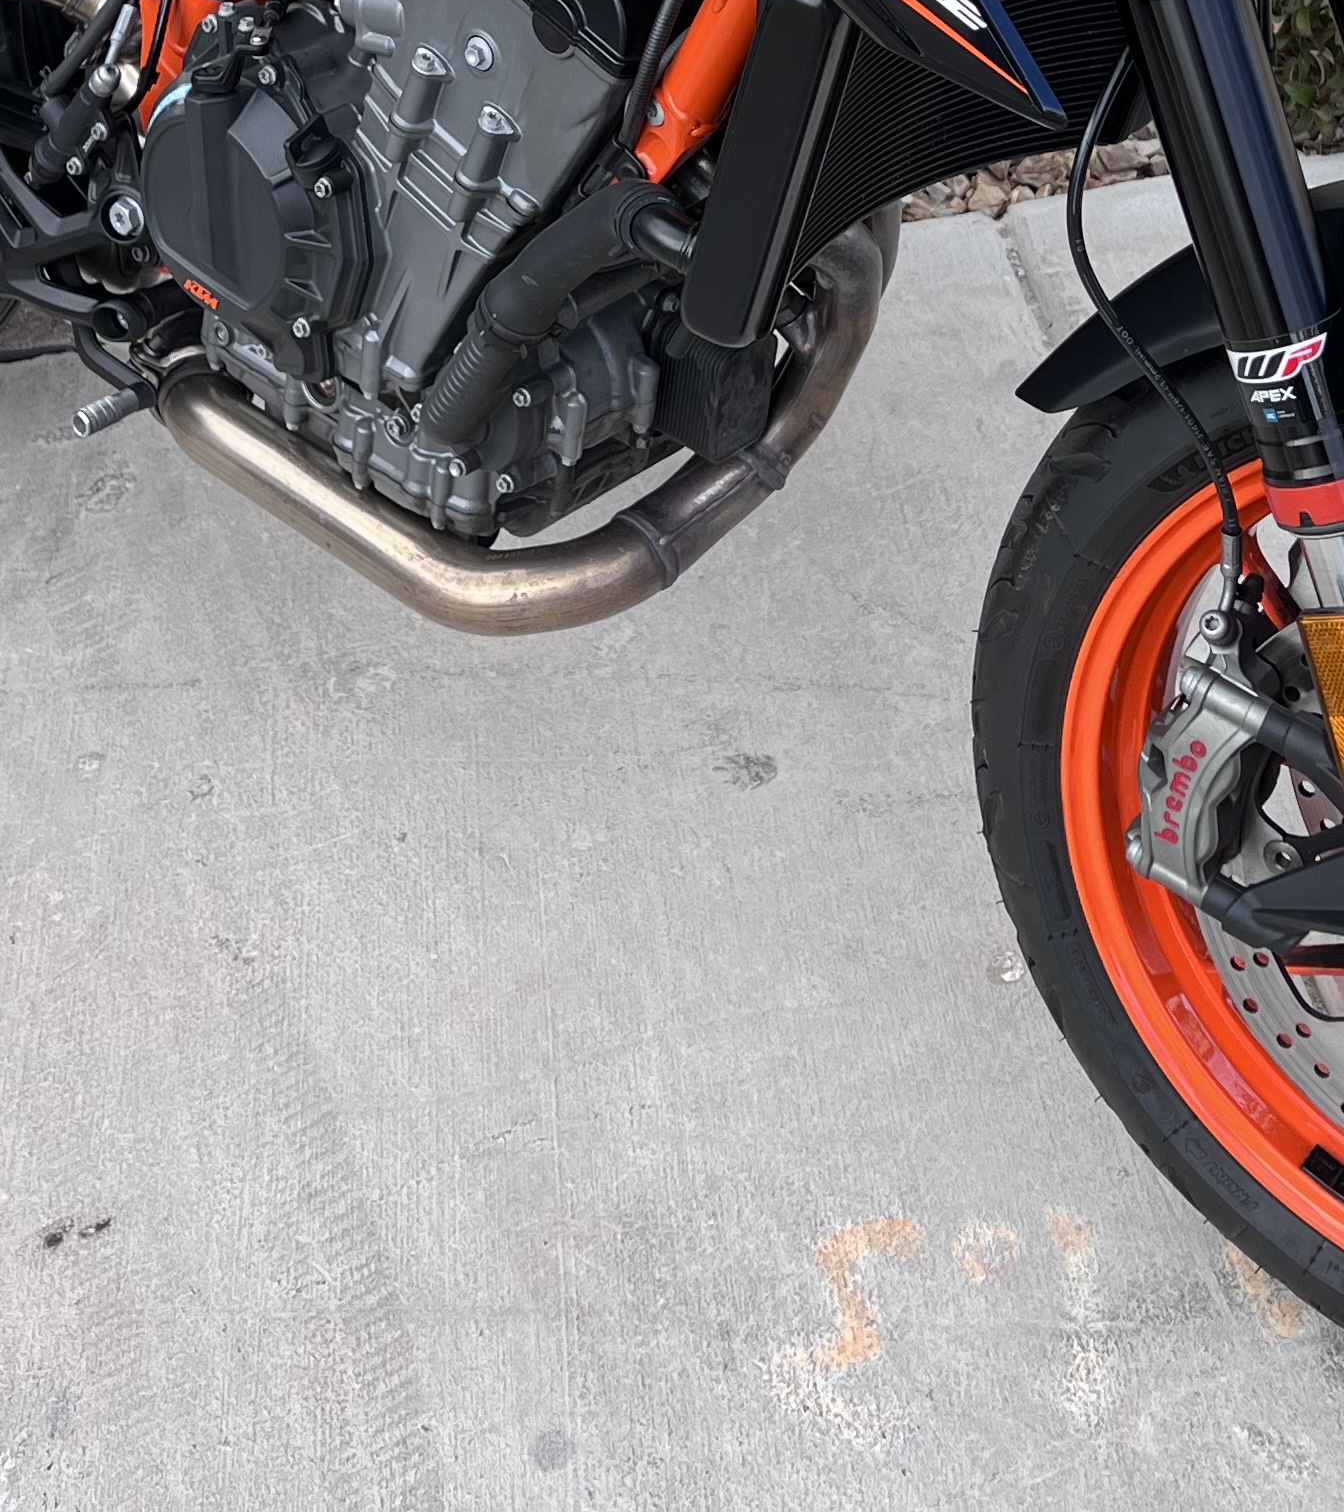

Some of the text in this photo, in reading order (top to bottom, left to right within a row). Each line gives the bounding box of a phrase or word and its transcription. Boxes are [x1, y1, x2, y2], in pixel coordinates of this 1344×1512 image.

[183, 278, 219, 311] KTM
[1234, 337, 1325, 381] WP
[1250, 386, 1297, 403] APEX
[1153, 739, 1208, 845] brembo
